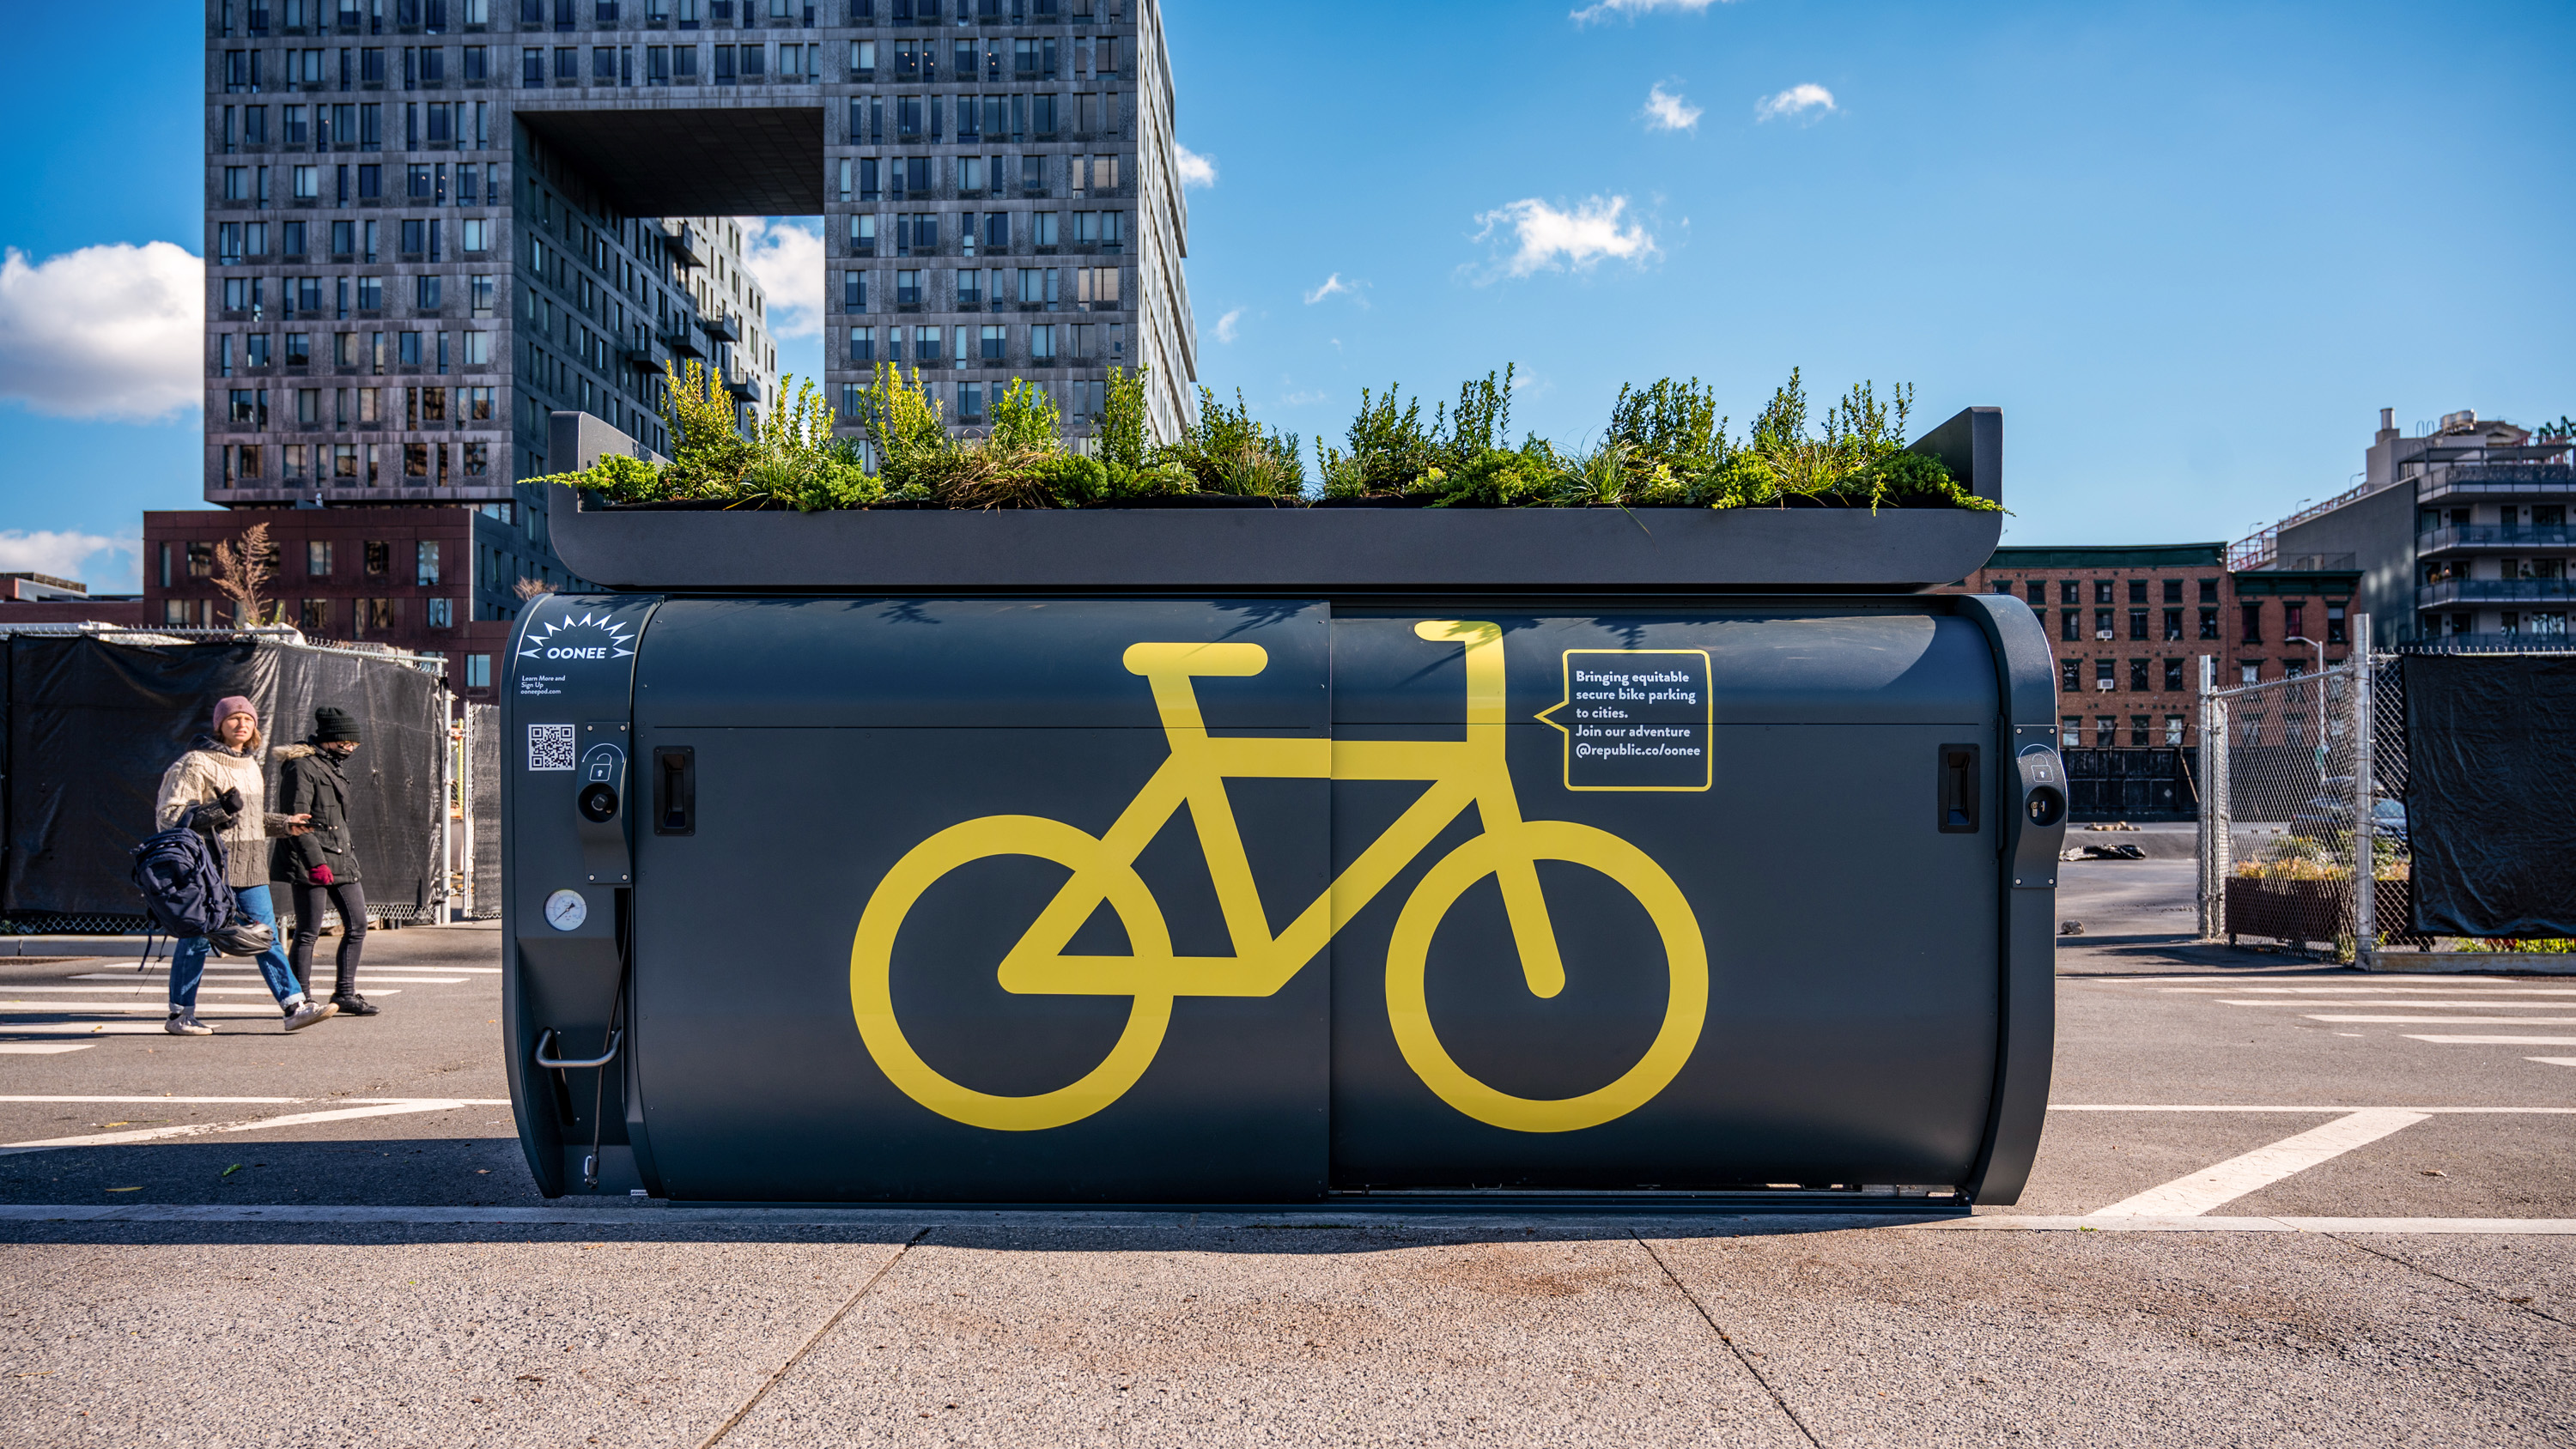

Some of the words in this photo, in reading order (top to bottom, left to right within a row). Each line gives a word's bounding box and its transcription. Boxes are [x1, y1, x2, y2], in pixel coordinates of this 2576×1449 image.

[547, 647, 607, 659] OONEE
[1577, 670, 1629, 686] Bringing
[1632, 671, 1689, 686] equitable
[1619, 688, 1645, 700] bike
[1649, 688, 1696, 704] parking
[1576, 708, 1589, 718] to
[1592, 706, 1628, 718] cities.
[1576, 724, 1601, 737] Join
[1629, 724, 1691, 737] adventure
[1577, 743, 1700, 760] @republic.co/oonee
